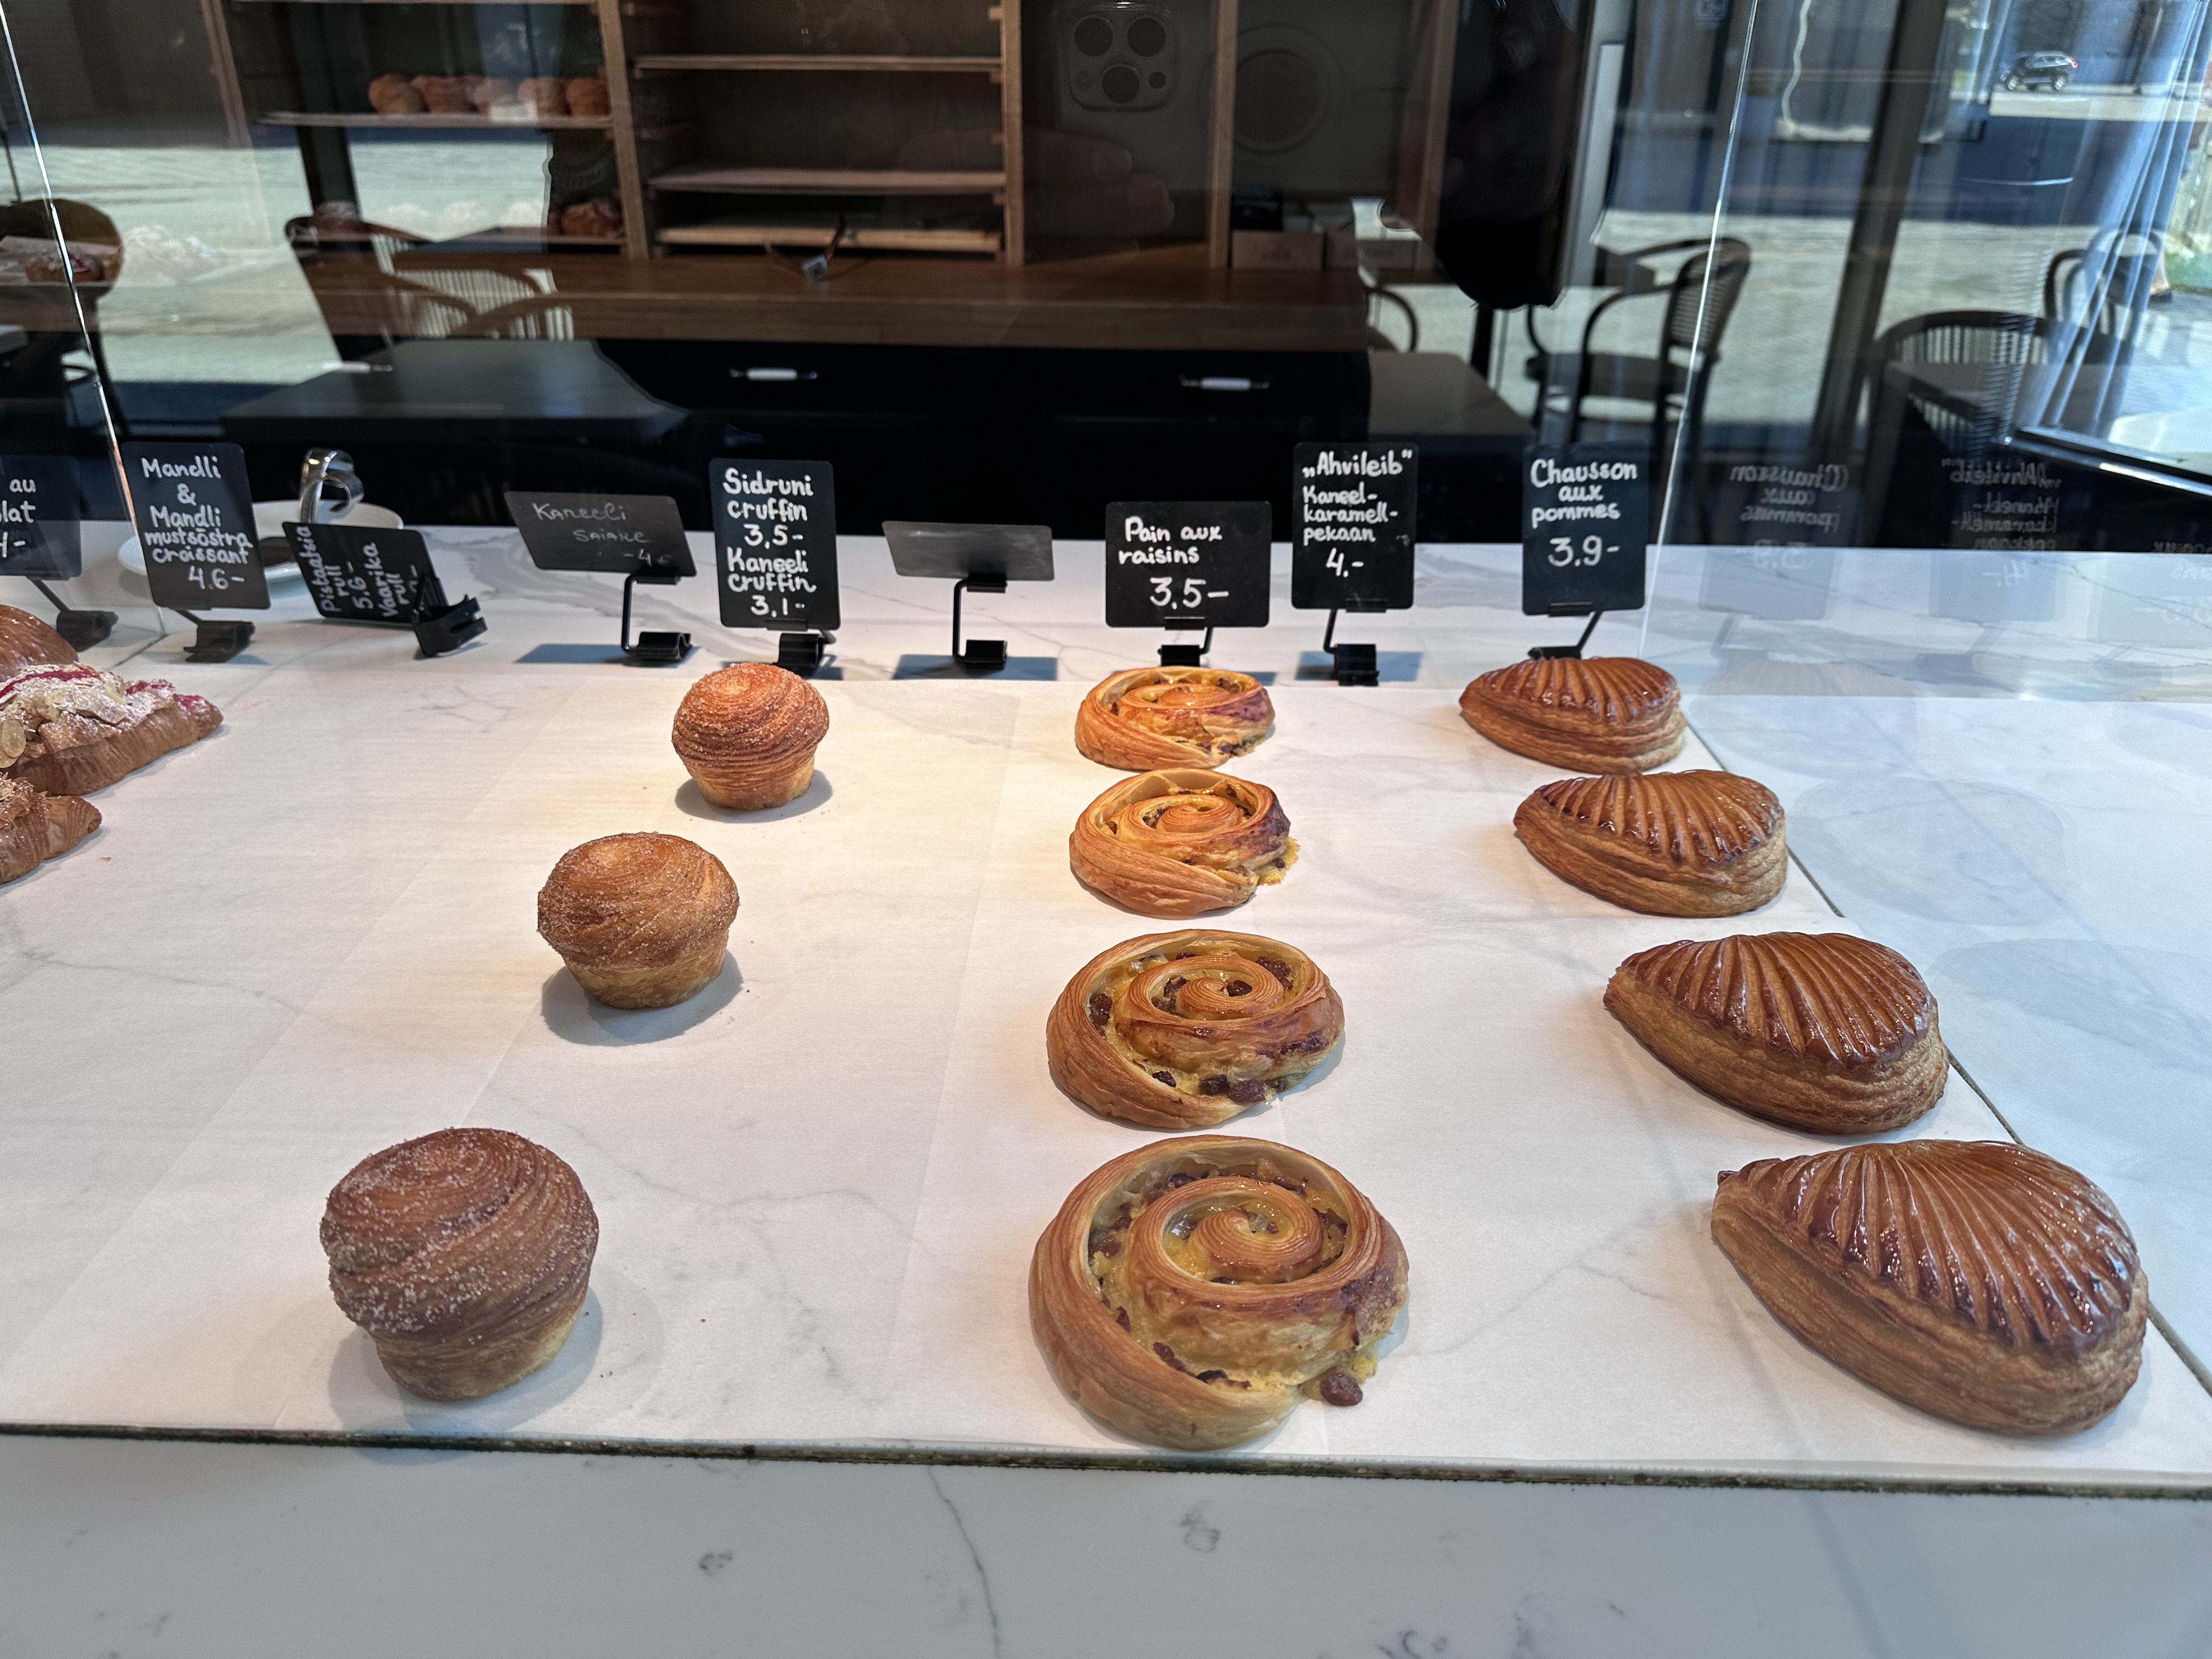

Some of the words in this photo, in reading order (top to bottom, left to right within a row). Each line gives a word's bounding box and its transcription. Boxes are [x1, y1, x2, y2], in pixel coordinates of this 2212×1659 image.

[142, 456, 221, 479] Mandli
[1530, 458, 1638, 488] Chausson
[10, 478, 36, 493] au
[723, 467, 814, 496] Sidruni
[1558, 484, 1604, 501] aux
[177, 483, 197, 506] &
[0, 500, 36, 523] lat
[150, 505, 222, 528] Mandli
[1304, 501, 1398, 524] karamell-
[1532, 502, 1621, 529] pommes
[1125, 516, 1171, 543] Pain
[1181, 525, 1222, 541] aux
[1303, 525, 1376, 546] pekaan
[726, 546, 809, 573] Kaneeli
[1118, 546, 1200, 565] raisins
[324, 565, 350, 597] rull
[362, 541, 399, 617] Vaarika
[386, 573, 410, 605] rull
